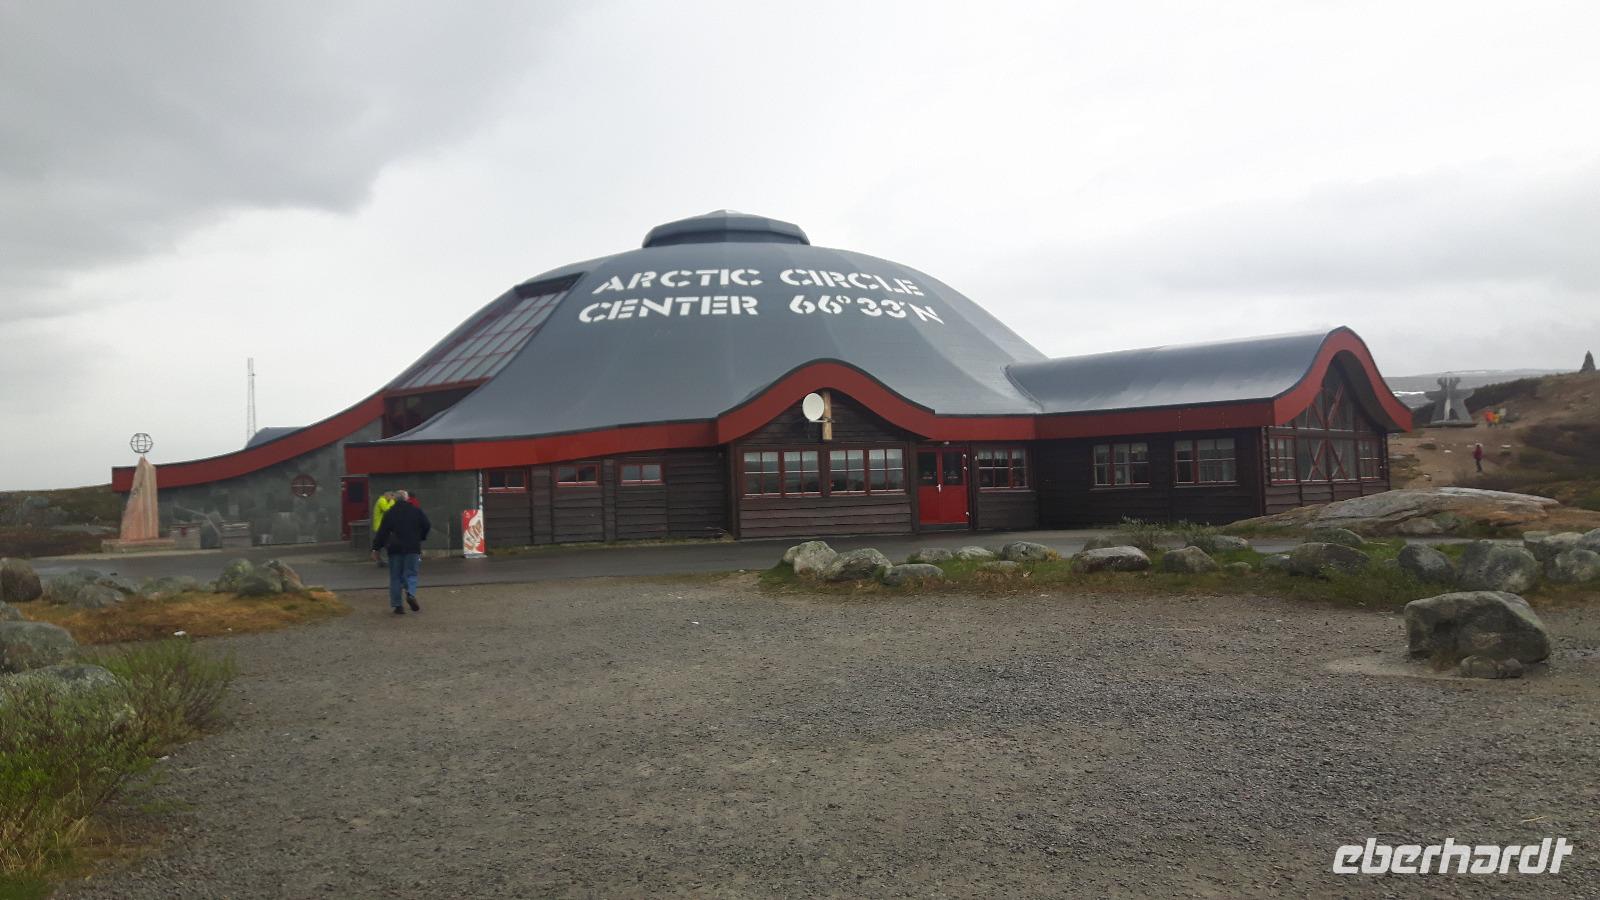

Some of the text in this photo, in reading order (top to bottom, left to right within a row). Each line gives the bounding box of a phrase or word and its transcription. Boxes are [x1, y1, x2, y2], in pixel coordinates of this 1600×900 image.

[593, 268, 925, 296] ARCTIC CIRCLE
[578, 296, 759, 323] CENTER
